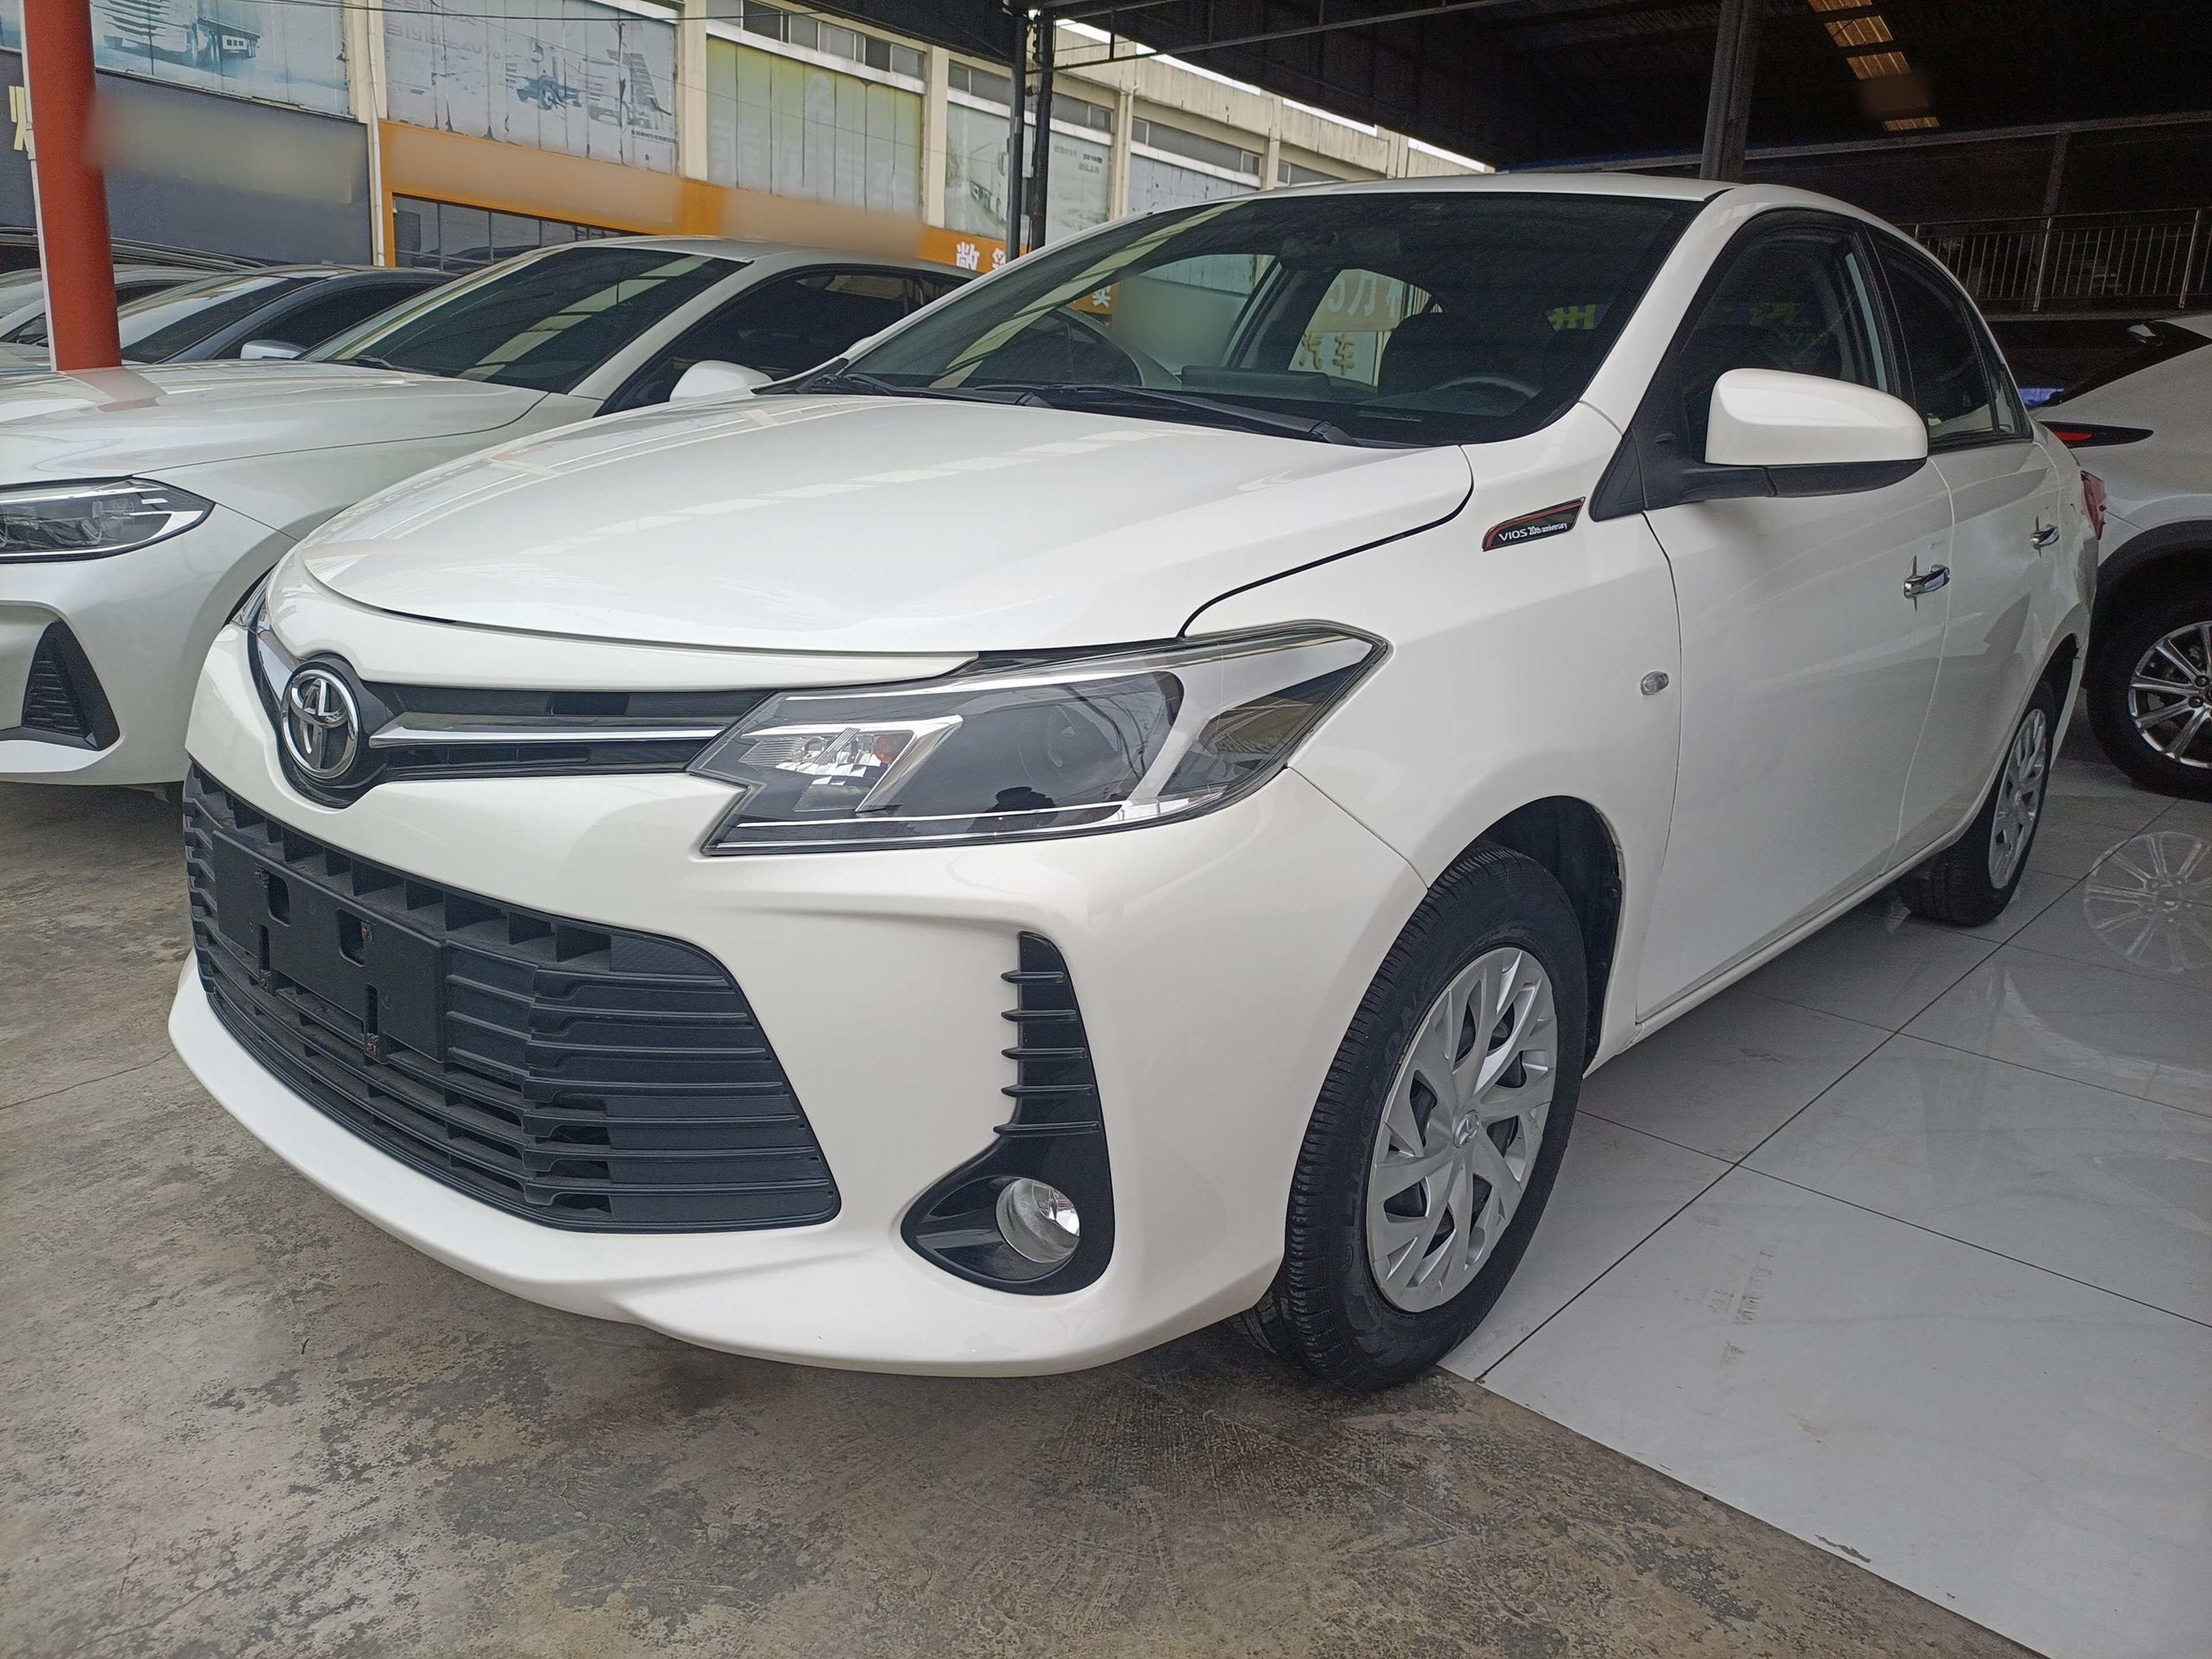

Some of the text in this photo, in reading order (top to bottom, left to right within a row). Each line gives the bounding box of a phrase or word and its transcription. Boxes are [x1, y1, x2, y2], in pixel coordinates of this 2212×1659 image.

[1298, 331, 1355, 376] 汽车
[1498, 522, 1567, 541] VIOS 20th anniversary
